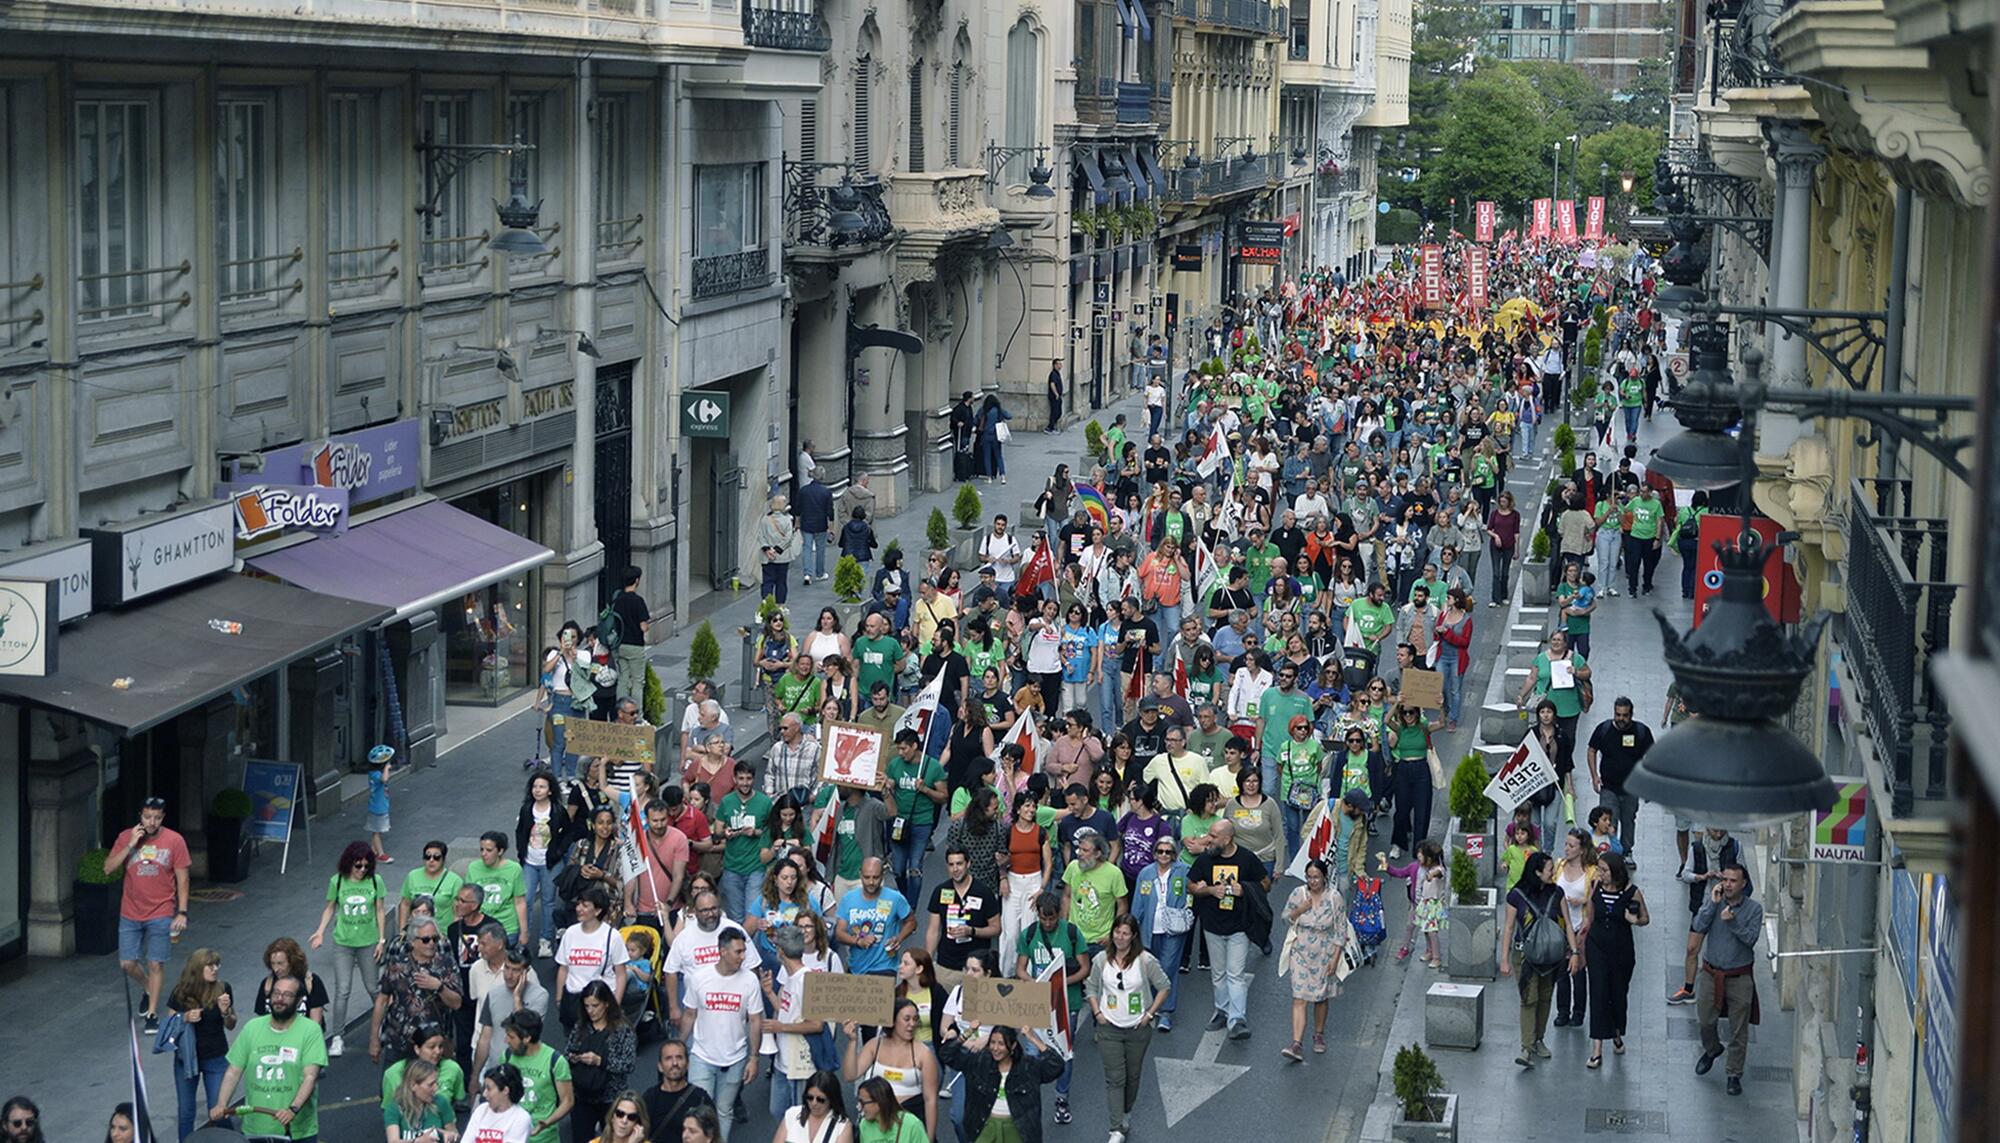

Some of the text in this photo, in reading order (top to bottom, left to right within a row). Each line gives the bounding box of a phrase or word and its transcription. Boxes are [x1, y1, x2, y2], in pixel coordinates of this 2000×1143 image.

[1480, 204, 1490, 234] UGT
[1537, 201, 1547, 230] UGT
[1560, 203, 1570, 235] UGT
[1589, 199, 1601, 232] UGT
[1425, 249, 1440, 301] CCOO
[1472, 250, 1483, 297] CCOO
[330, 446, 370, 488] Folder
[257, 493, 339, 526] Folder
[154, 529, 225, 566] GHAMTTON
[63, 570, 89, 596] TON
[706, 992, 741, 1002] SALVEM
